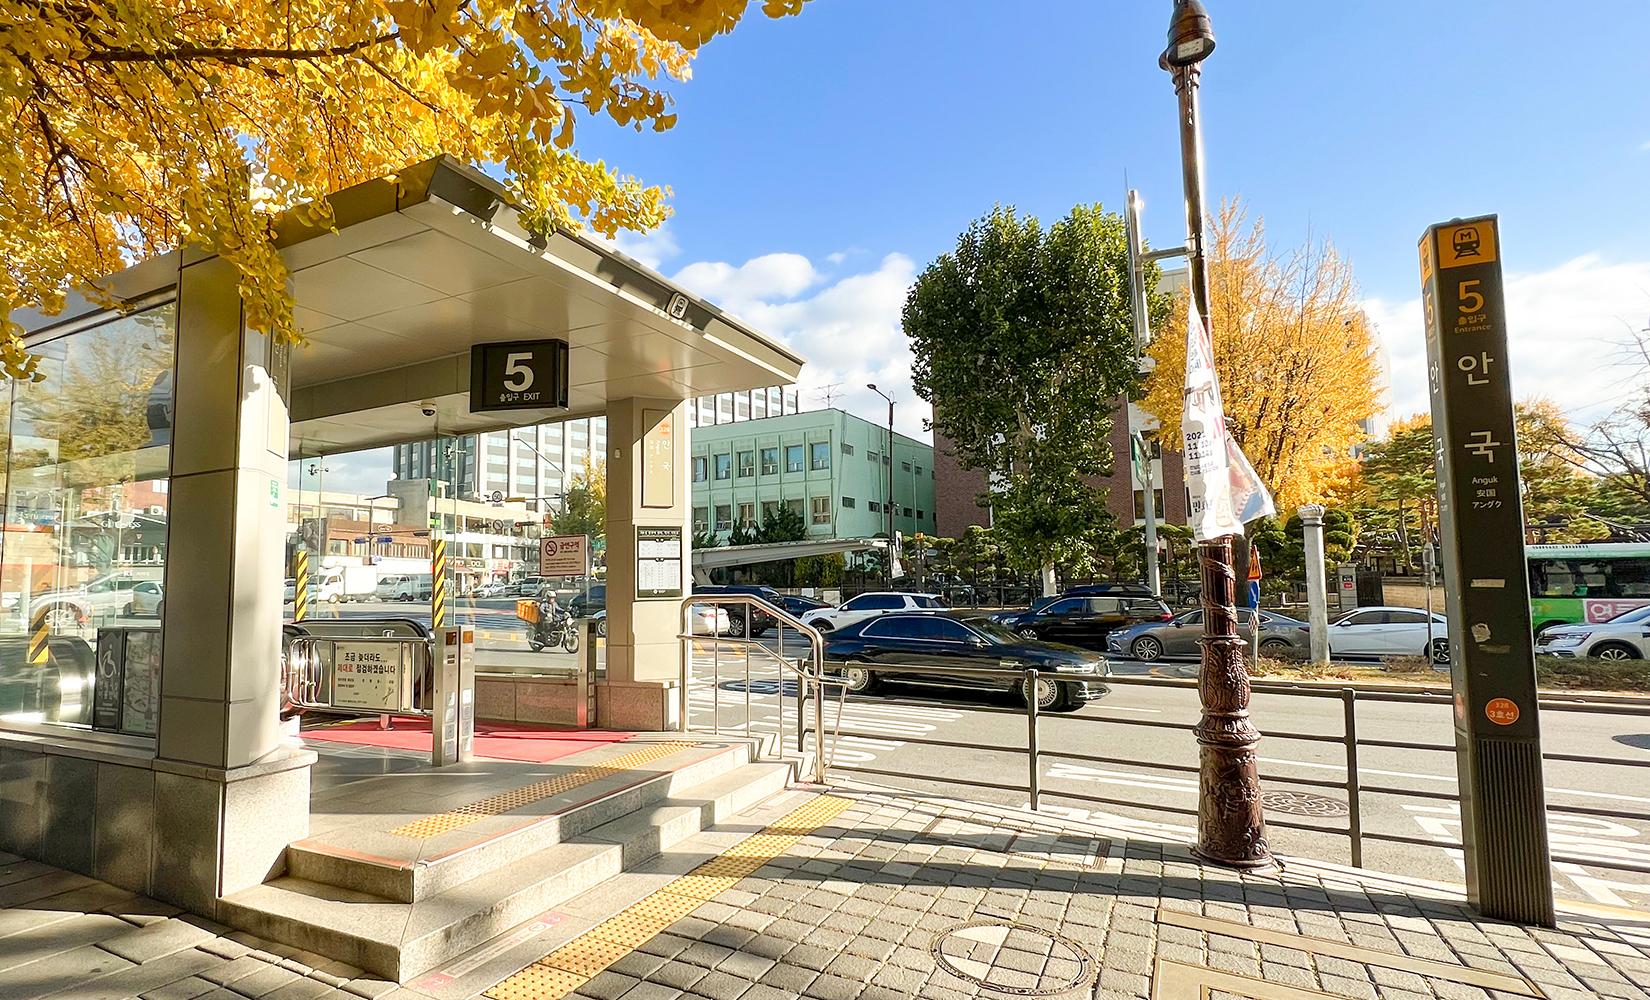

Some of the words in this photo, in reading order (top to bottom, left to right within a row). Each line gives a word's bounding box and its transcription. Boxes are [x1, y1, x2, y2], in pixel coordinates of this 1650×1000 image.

[1457, 279, 1486, 314] 5
[1426, 291, 1434, 325] 5
[1454, 324, 1492, 334] Entrance
[503, 352, 534, 392] 5
[499, 392, 520, 402] 출입구
[523, 391, 541, 401] EXIT
[1471, 475, 1499, 486] Anguk
[1471, 500, 1502, 510] アングク
[1489, 710, 1515, 720] 3호선
